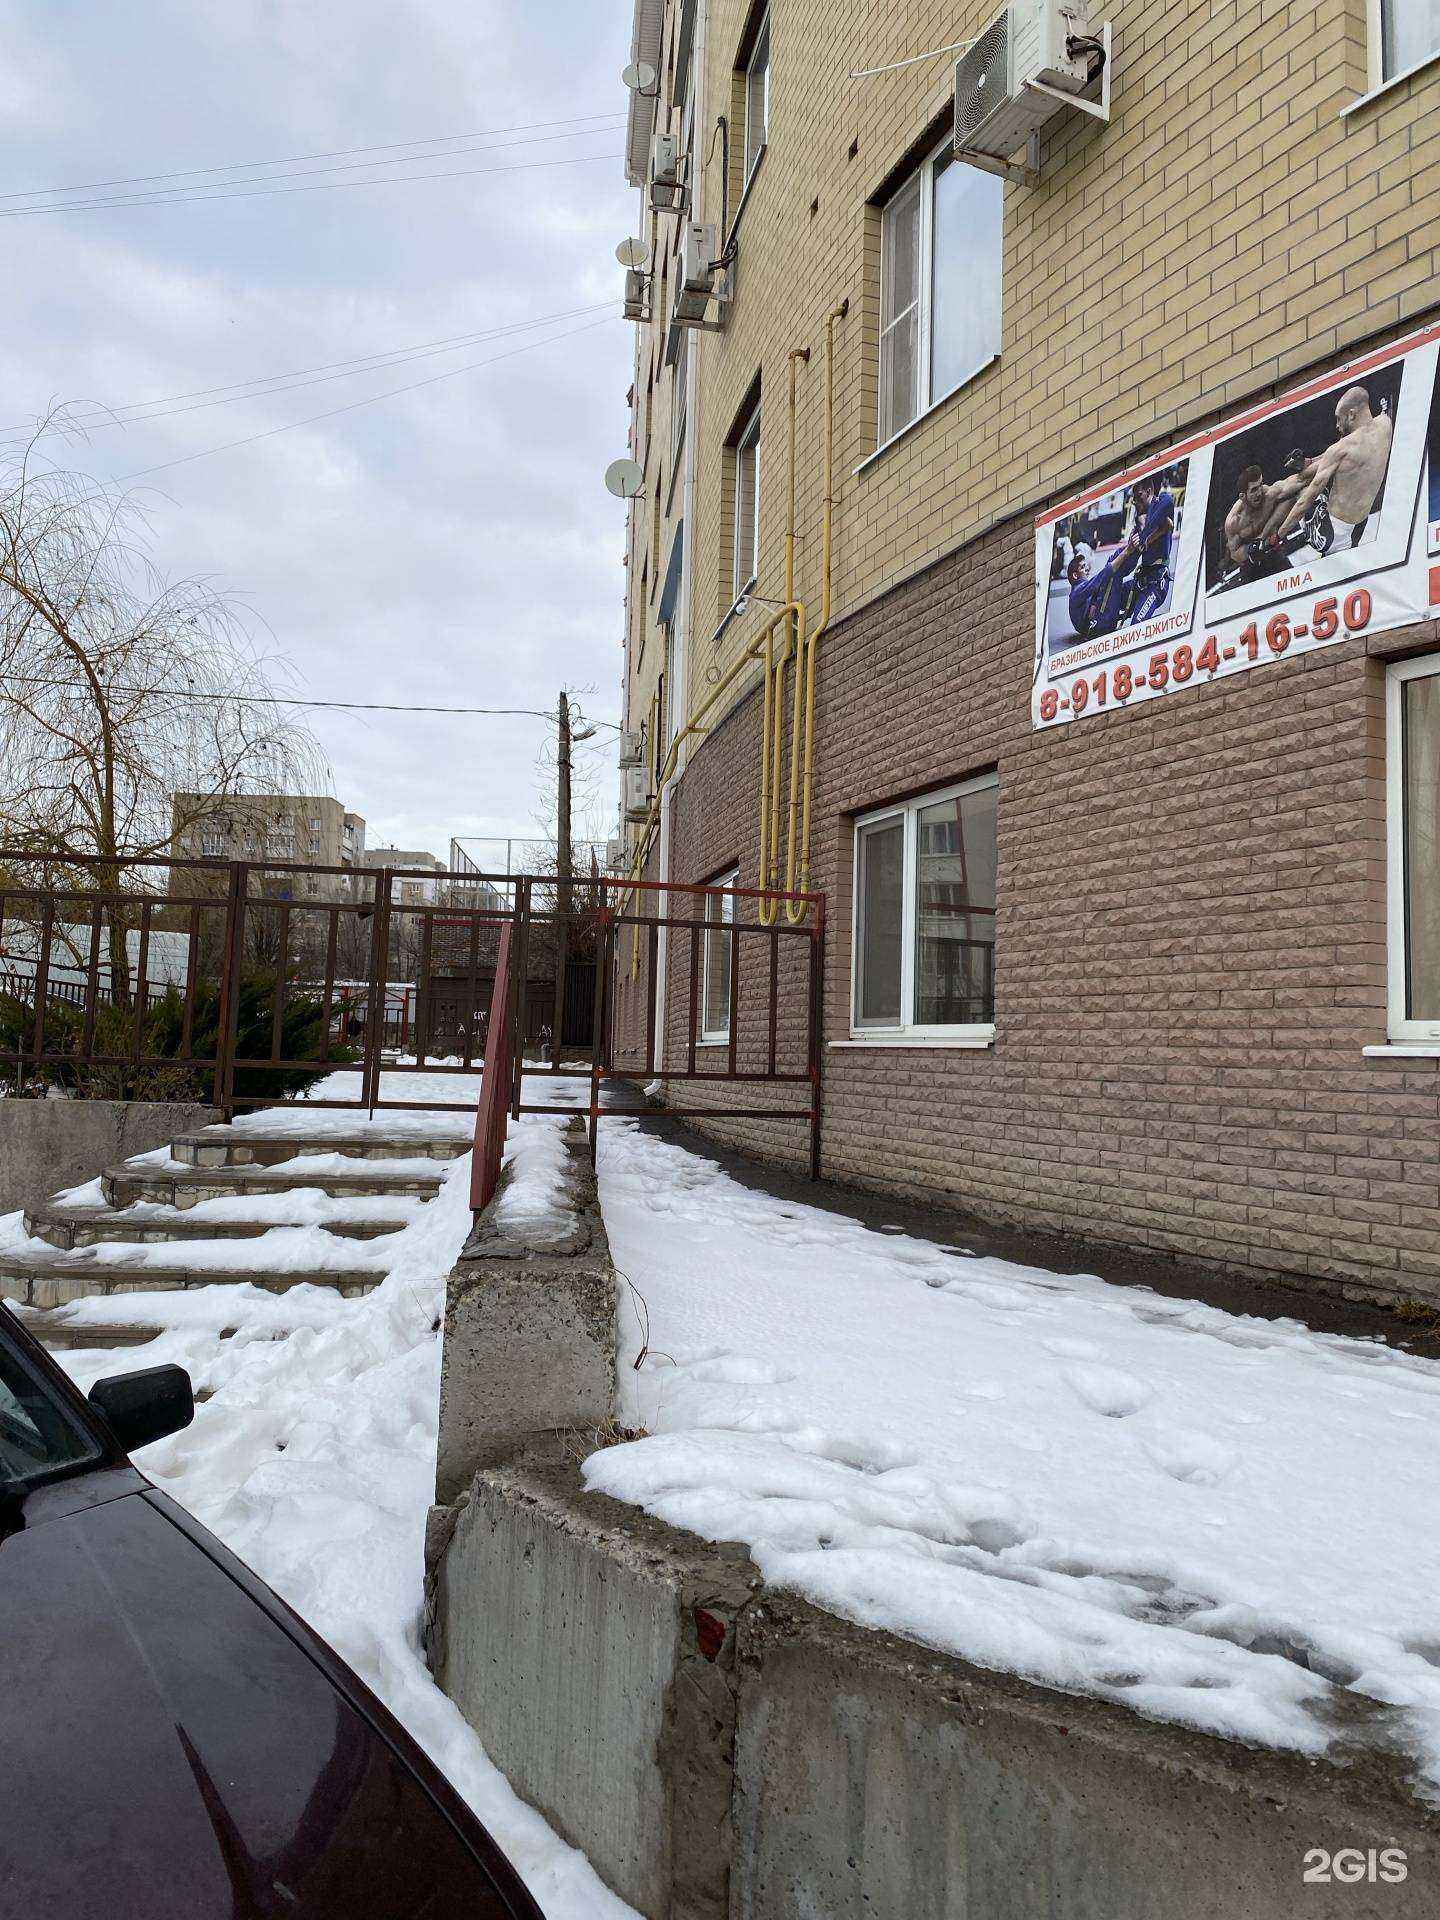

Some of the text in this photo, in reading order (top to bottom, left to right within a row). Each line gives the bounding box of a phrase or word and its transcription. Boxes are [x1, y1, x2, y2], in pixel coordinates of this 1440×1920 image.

[1277, 571, 1313, 592] ММА
[1040, 588, 1373, 721] 8-918-584-16-50
[1050, 612, 1190, 671] БРАЗИЛЬСКОЕ ДЖИУ-ДЖИТСУ
